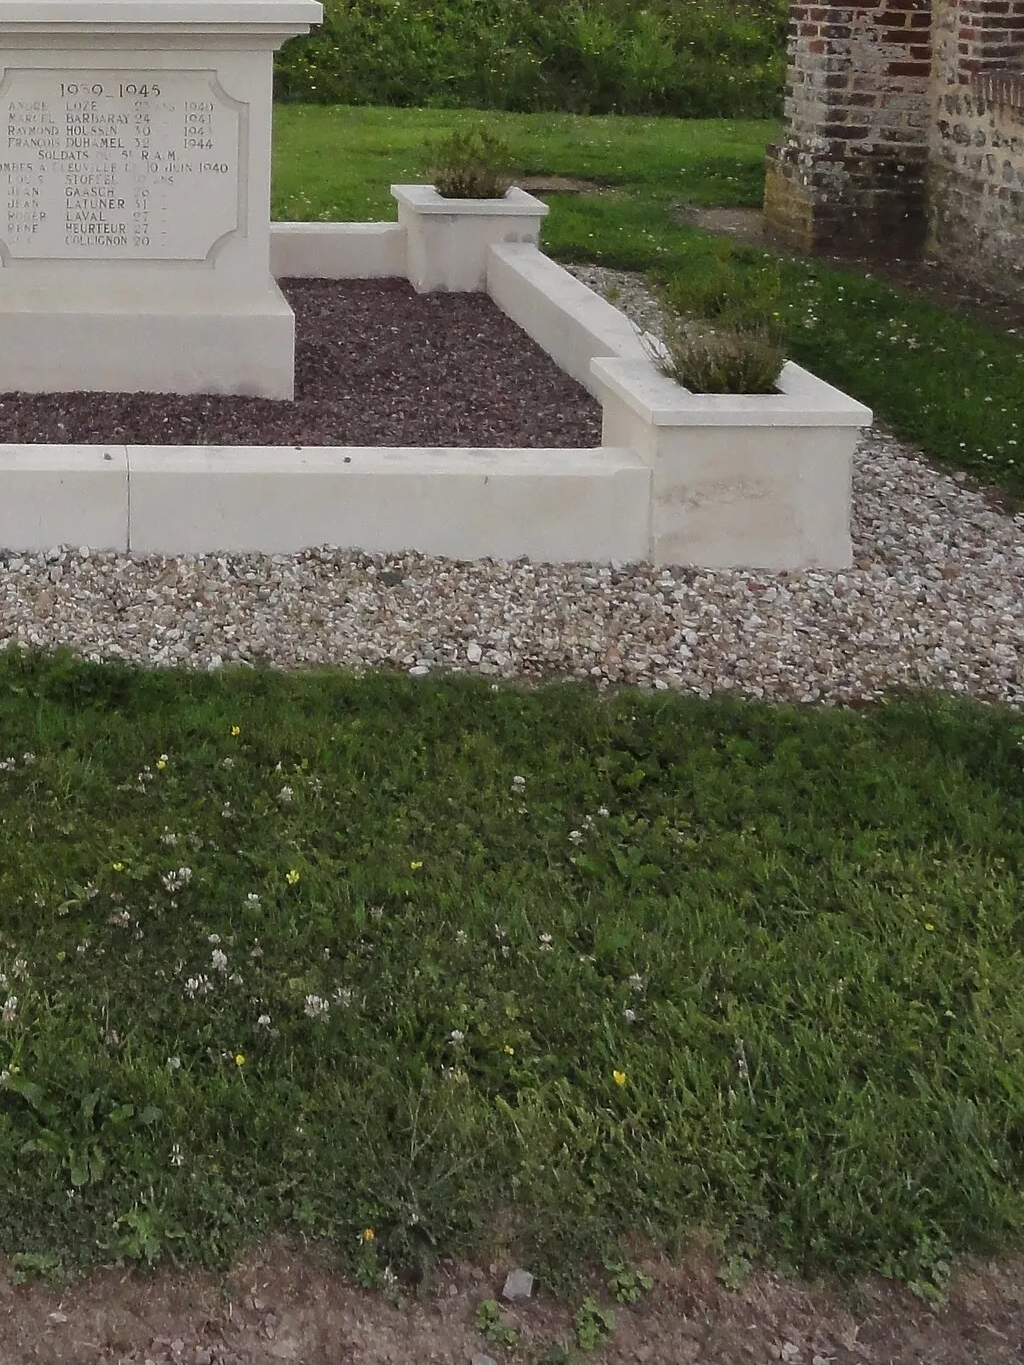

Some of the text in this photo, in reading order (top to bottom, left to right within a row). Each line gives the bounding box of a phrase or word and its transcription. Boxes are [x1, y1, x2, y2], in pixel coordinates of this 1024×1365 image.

[65, 113, 130, 124] BARBARAY
[8, 125, 59, 135] RAYMOND
[65, 137, 125, 149] DUHAMEL
[183, 138, 213, 149] 1944
[38, 150, 89, 160] SOLDATS
[52, 162, 116, 172] CLEUVLLE
[199, 163, 228, 173] 1940
[8, 174, 44, 185] LOS
[64, 186, 115, 197] GAASCH
[8, 198, 39, 209] JEAN
[65, 211, 107, 222] LAVAL
[65, 223, 126, 234] HEURTEUR
[65, 236, 128, 246] COLLIGNON
